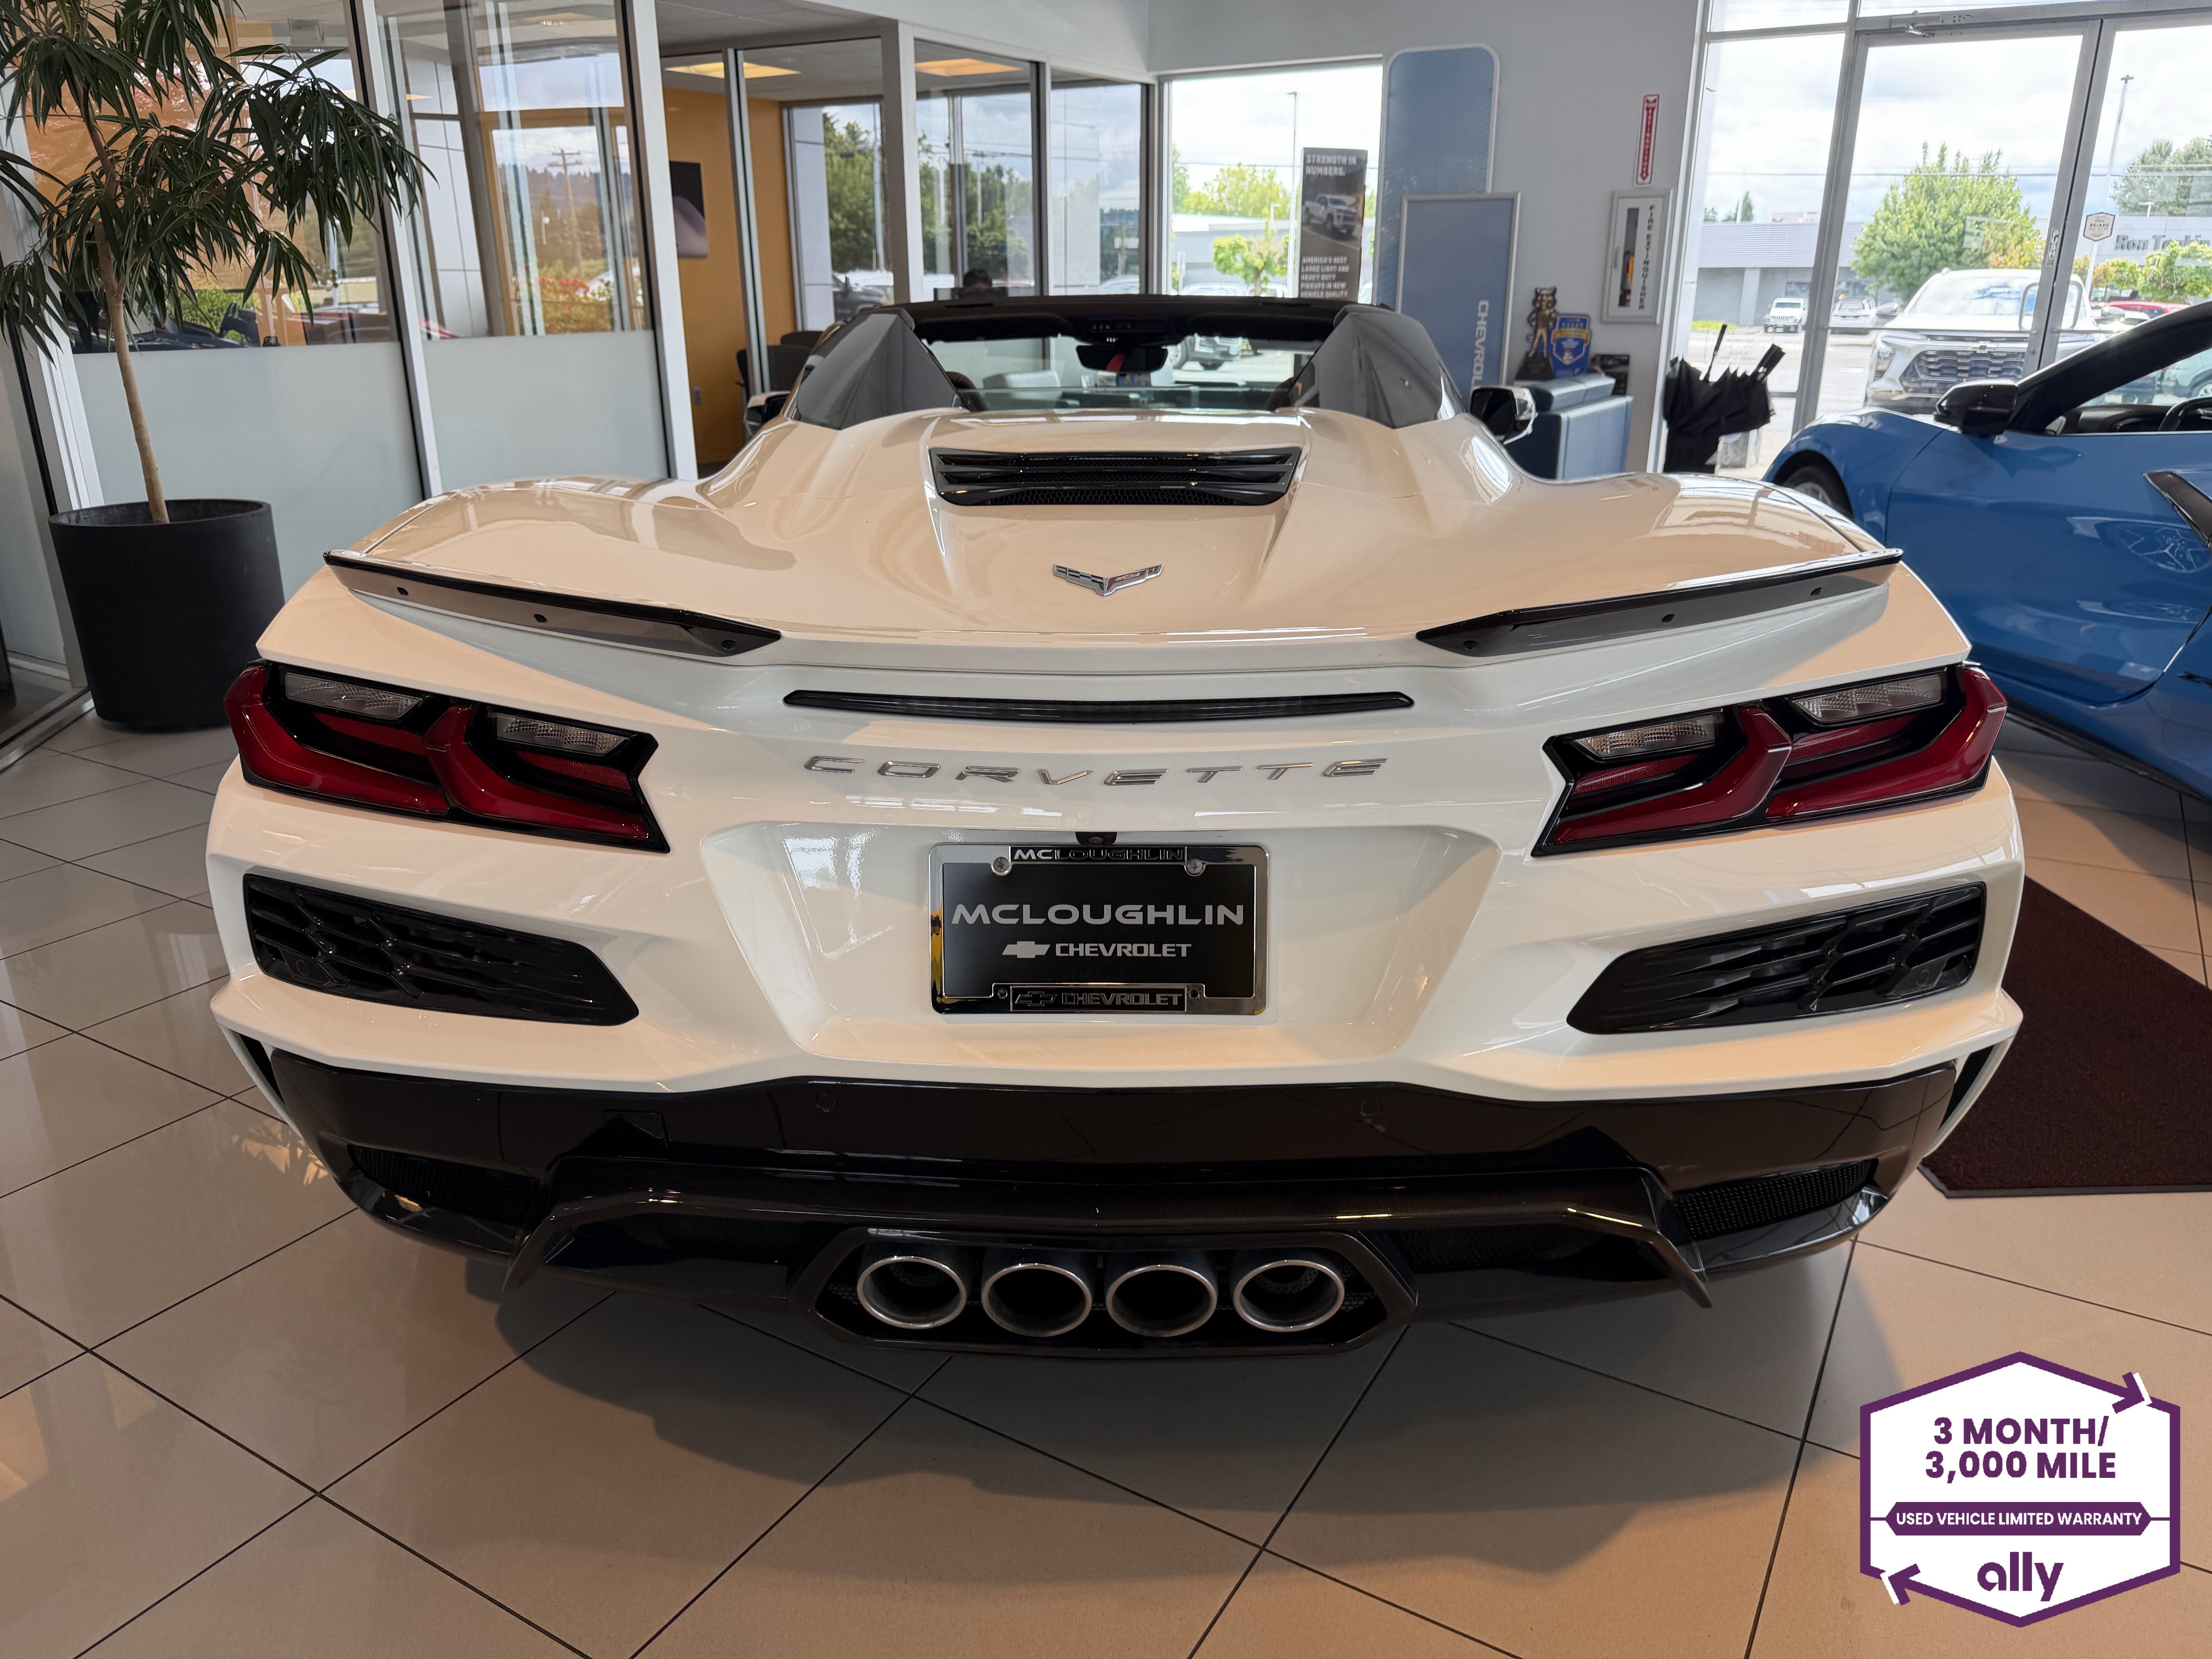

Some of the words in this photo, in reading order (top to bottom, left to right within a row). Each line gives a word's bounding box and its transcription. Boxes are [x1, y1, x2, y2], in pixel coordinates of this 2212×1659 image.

[1306, 155, 1347, 165] STRENGTH
[1348, 155, 1357, 165] IN
[2115, 235, 2148, 251] Ron
[1471, 300, 1489, 389] CHEVROL
[804, 755, 1388, 786] CORVETTE
[1013, 848, 1183, 861] MCLOUGHLIN
[951, 904, 1244, 925] MCLOUGHLIN
[1056, 943, 1192, 957] CHEVROLET
[1061, 993, 1182, 1005] CHEVROLET
